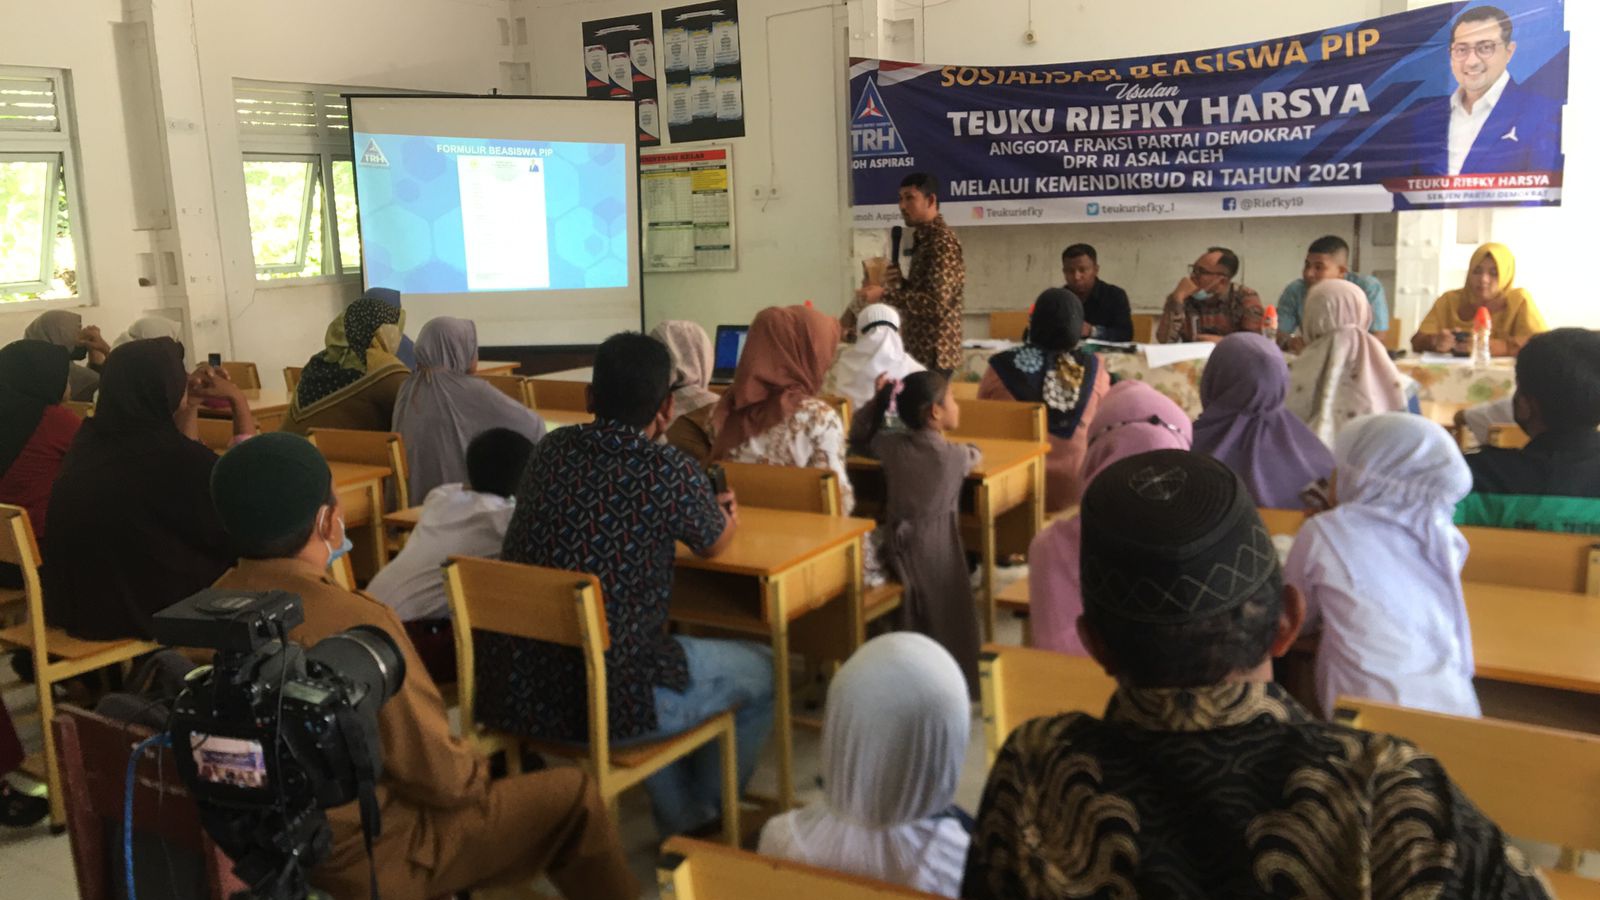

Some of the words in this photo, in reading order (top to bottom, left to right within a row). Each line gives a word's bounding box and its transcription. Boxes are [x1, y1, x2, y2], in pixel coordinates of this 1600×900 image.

[1130, 41, 1309, 79] BEASISWA
[1322, 29, 1381, 61] PIP
[1106, 82, 1180, 100] Usulan
[947, 108, 1055, 136] TEUKU
[1066, 99, 1189, 132] RIEFKY
[1201, 84, 1370, 125] HARSYA
[851, 127, 895, 151] TRH
[989, 140, 1068, 156] ANGGOTA
[1074, 137, 1132, 152] FRAKSI
[1138, 133, 1200, 149] PARTAI
[1205, 125, 1315, 146] DEMOKRAT
[365, 153, 385, 163] TRH
[436, 144, 486, 155] FORMULIR
[489, 146, 538, 157] BEASISWA
[539, 148, 554, 157] PIP
[852, 159, 867, 170] OH
[869, 157, 914, 169] ASPIRASI
[1063, 155, 1098, 169] DPR
[1103, 154, 1120, 167] RI
[1125, 152, 1170, 167] ASAL
[1174, 149, 1224, 165] ACEH
[951, 178, 1029, 196] MELALUI
[1035, 171, 1186, 193] KEMENDIKBUD
[1192, 171, 1213, 188] RI
[1220, 165, 1300, 186] TAHUN
[1308, 162, 1363, 182] 2021
[1408, 178, 1449, 190] TEUKU
[1453, 176, 1494, 188] RIEFKY
[1498, 175, 1549, 187] HARSYA
[1463, 190, 1495, 200] PARTAI
[986, 206, 1044, 218] Teukuriefky
[1101, 202, 1175, 215] teukuriefky_1
